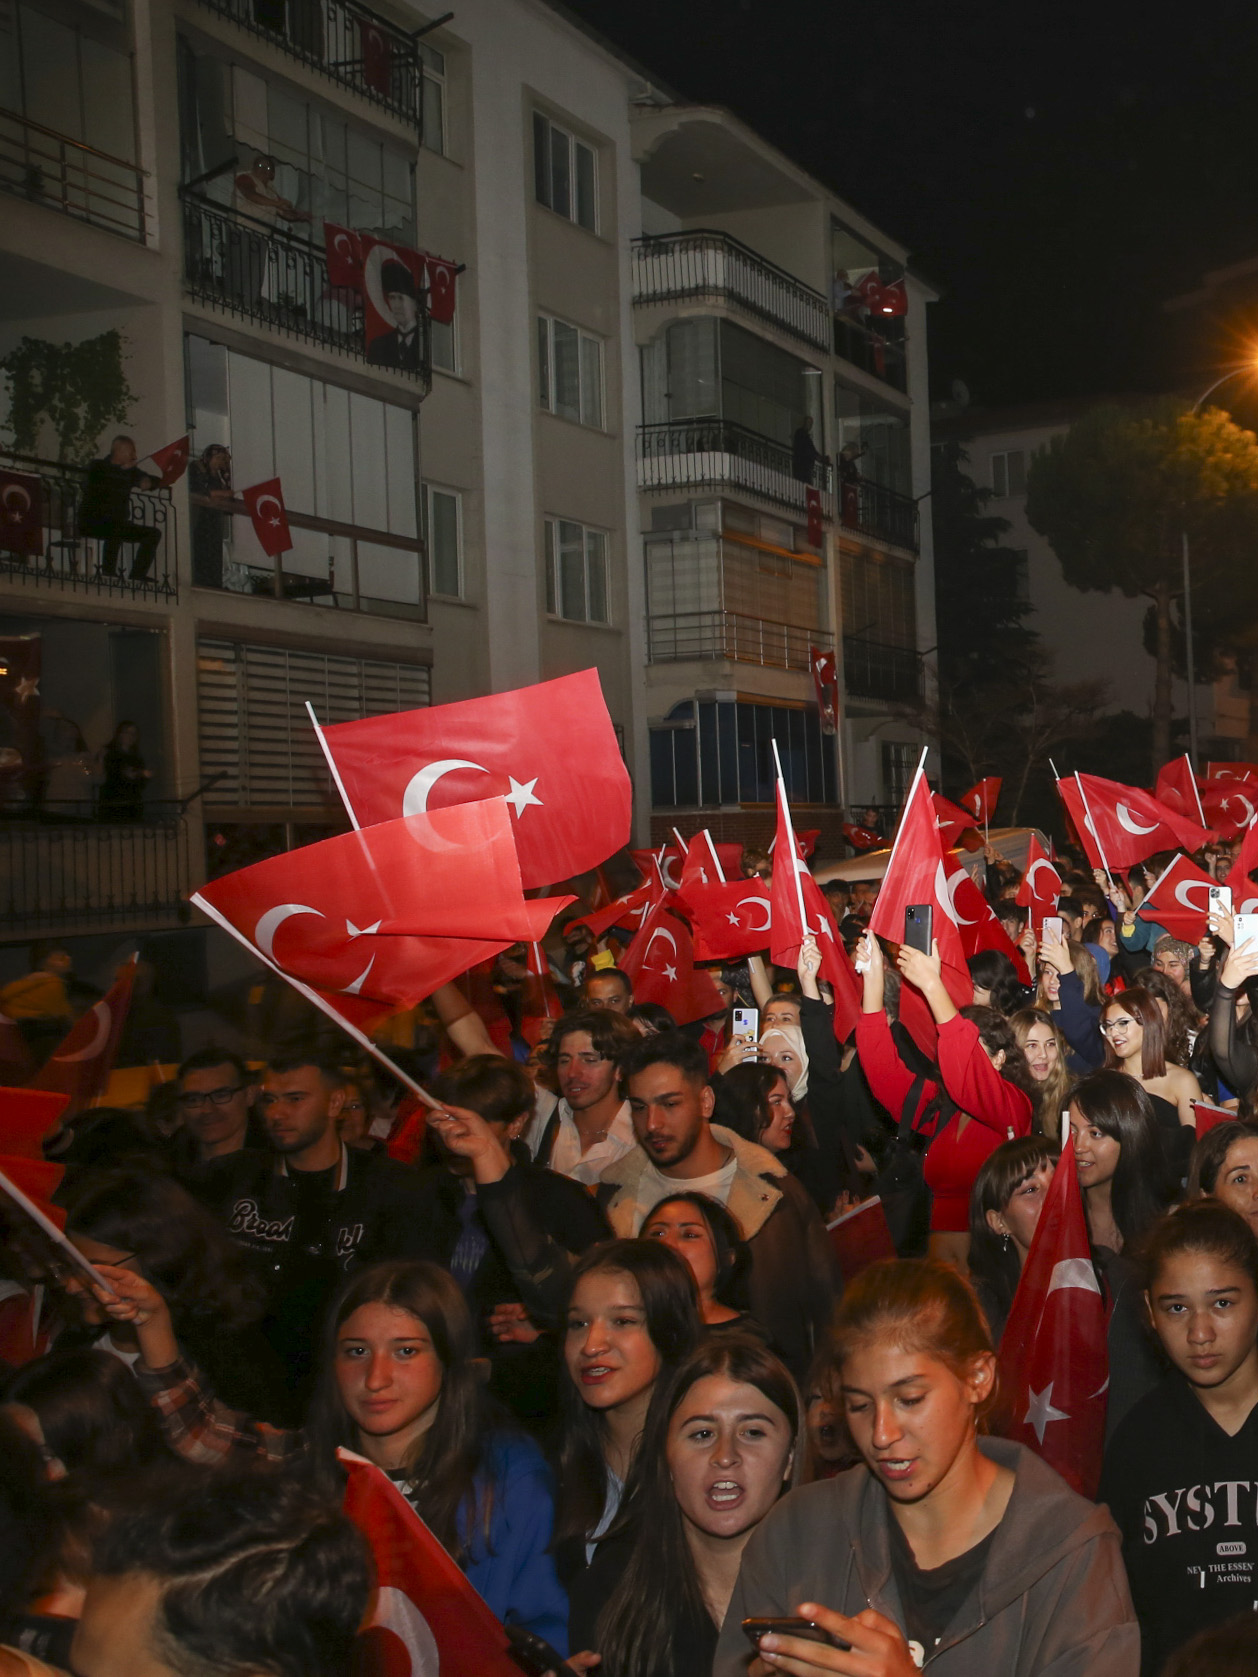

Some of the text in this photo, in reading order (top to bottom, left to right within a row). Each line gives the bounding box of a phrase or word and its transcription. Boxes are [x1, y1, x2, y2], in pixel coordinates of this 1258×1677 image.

[1219, 1544, 1244, 1553] ABOVE
[1208, 1563, 1227, 1573] THE
[1216, 1573, 1252, 1583] Archives
